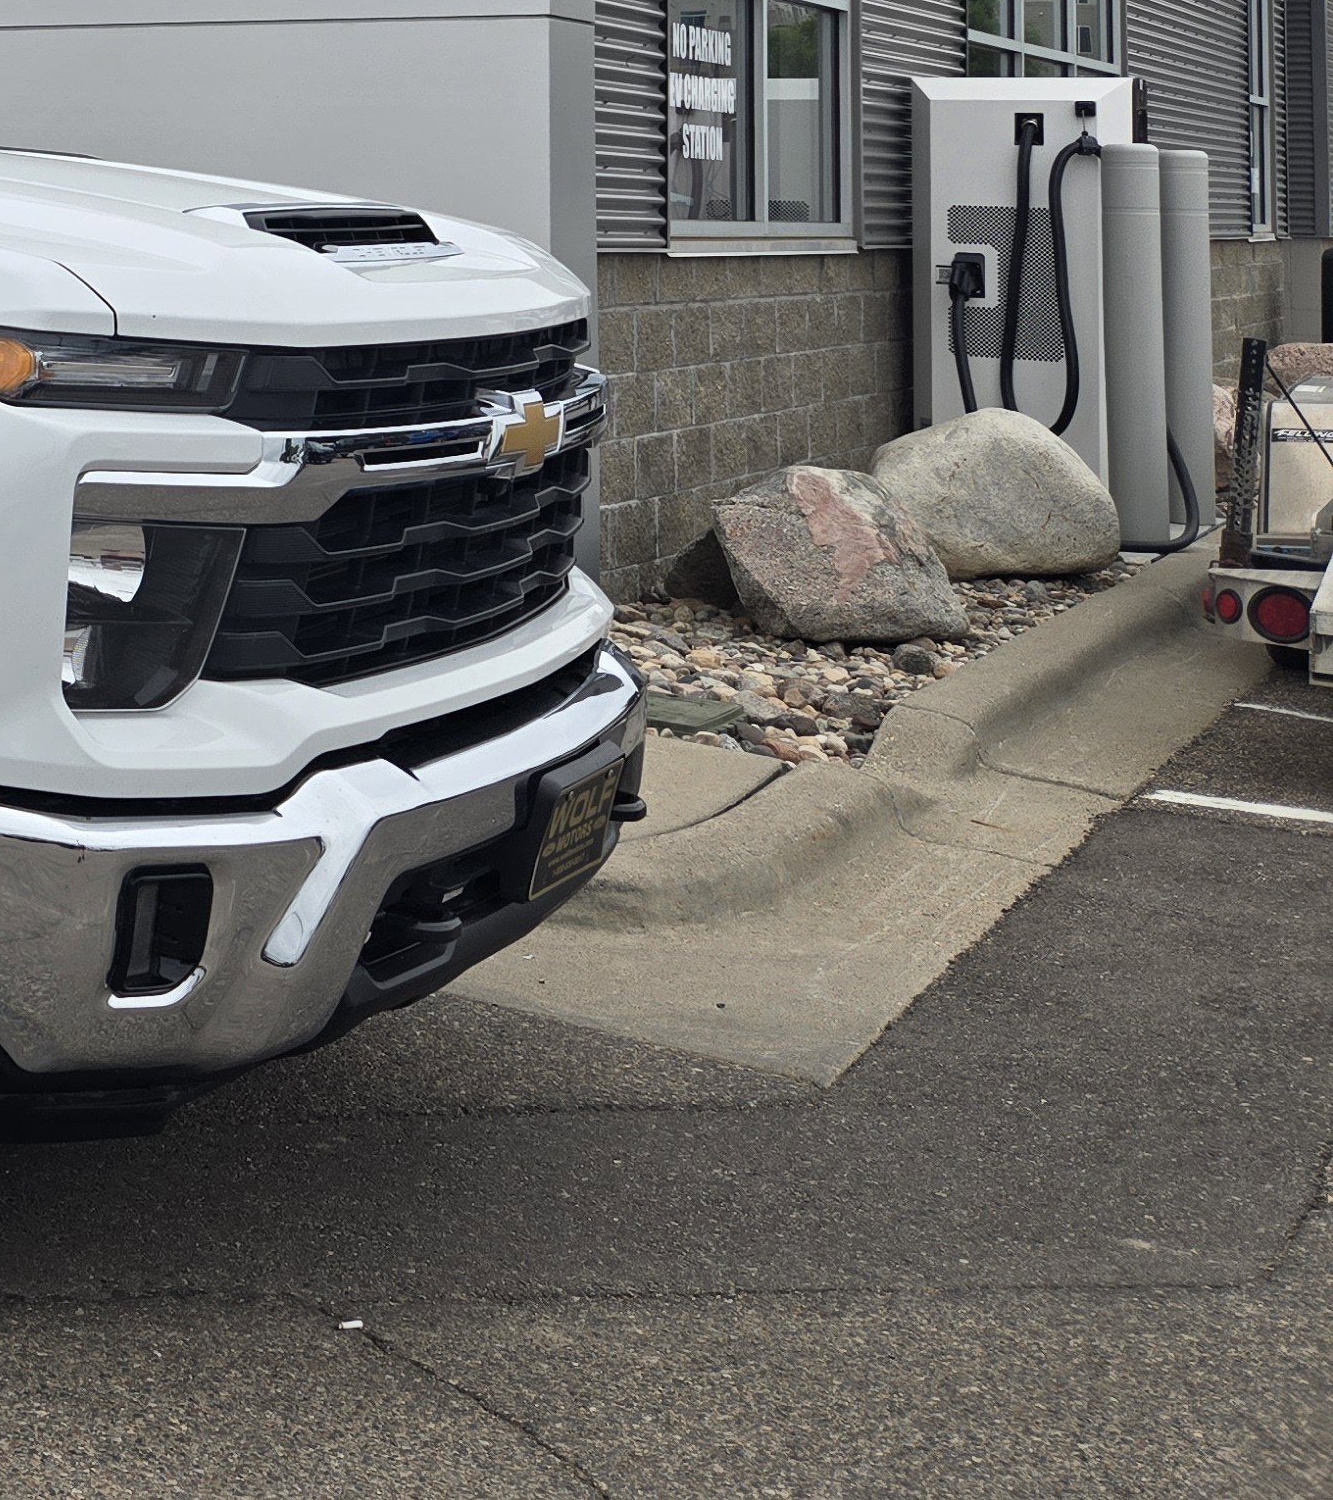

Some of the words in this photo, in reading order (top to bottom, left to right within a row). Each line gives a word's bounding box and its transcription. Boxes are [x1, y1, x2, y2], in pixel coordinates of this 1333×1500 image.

[672, 21, 687, 60] NO
[688, 24, 732, 67] PARKING
[683, 73, 736, 115] CHARGING
[682, 122, 723, 161] STATION
[549, 777, 618, 839] WOLF
